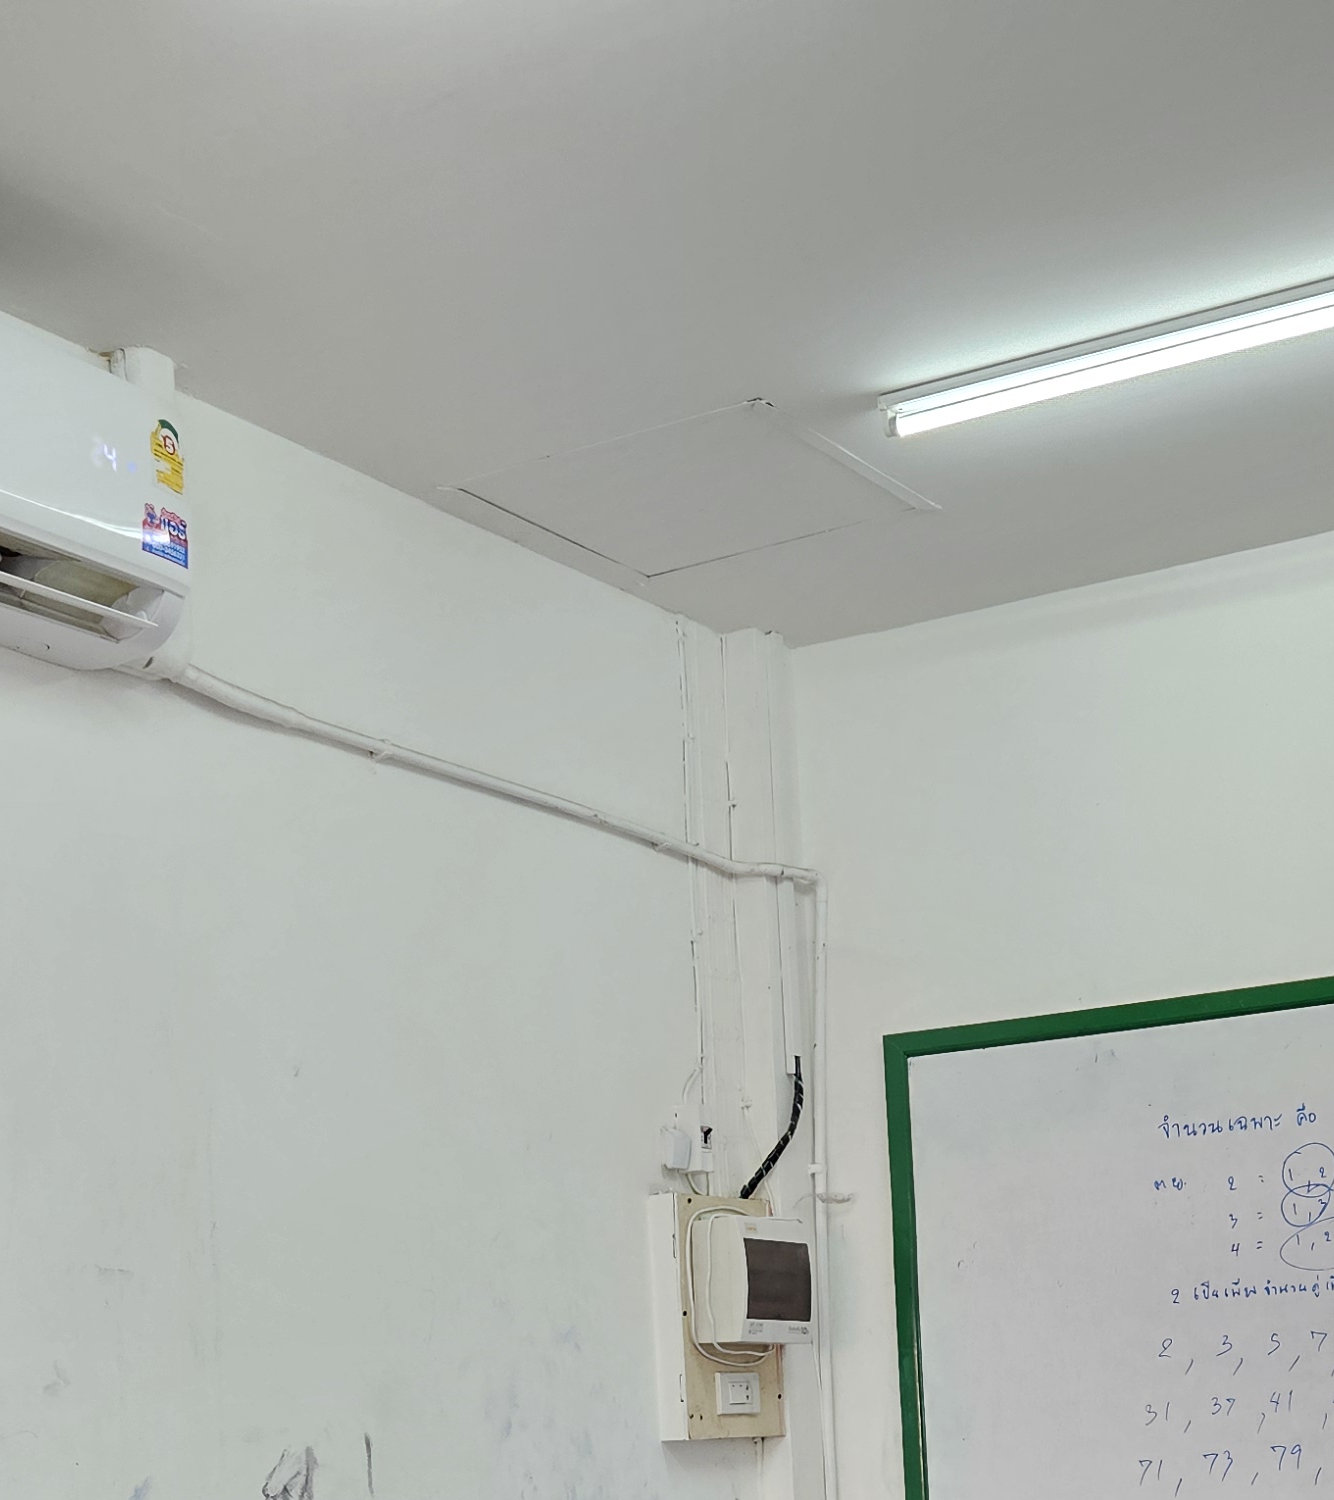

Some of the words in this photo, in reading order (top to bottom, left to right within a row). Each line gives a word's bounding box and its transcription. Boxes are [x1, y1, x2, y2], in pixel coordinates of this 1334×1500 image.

[1157, 1113, 1283, 1139] จำนวนเฉพาะ
[1296, 1102, 1317, 1127] คือ
